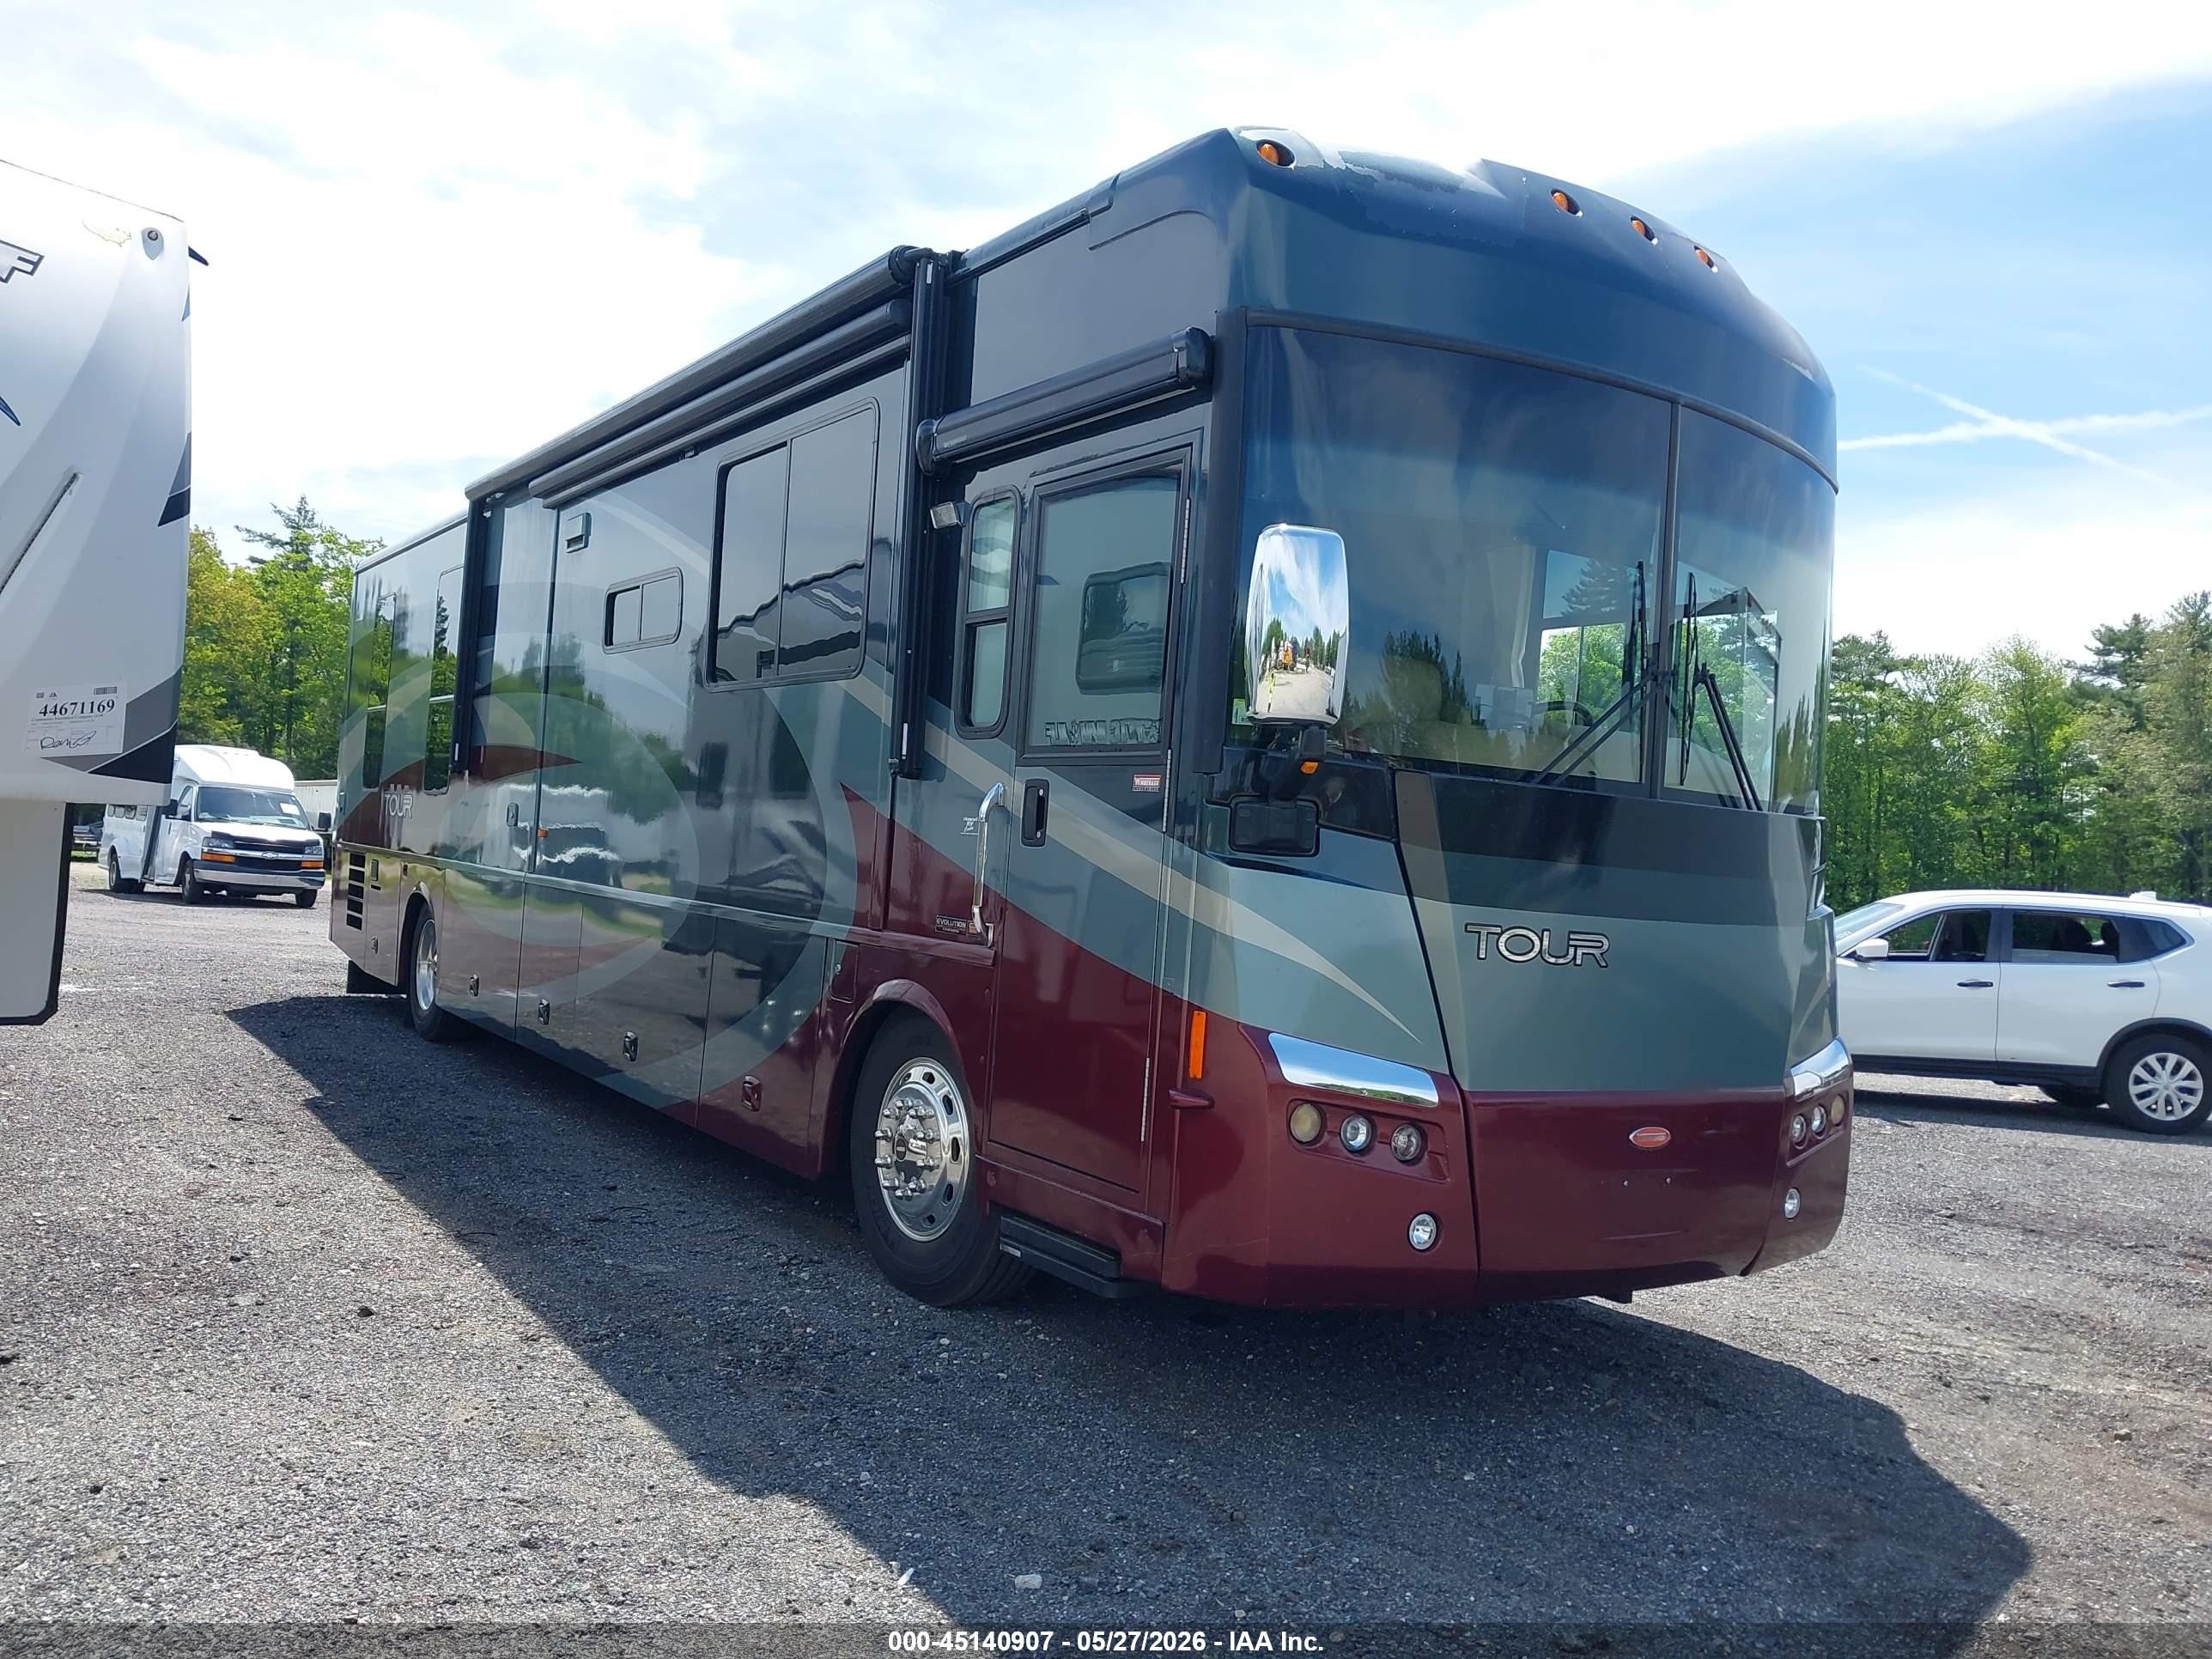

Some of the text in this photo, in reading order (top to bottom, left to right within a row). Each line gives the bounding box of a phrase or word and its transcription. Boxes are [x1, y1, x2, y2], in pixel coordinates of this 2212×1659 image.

[39, 699, 115, 717] 44671169
[384, 791, 413, 818] TOUR
[936, 918, 966, 928] EVOLUTION
[1464, 921, 1610, 968] TOUR
